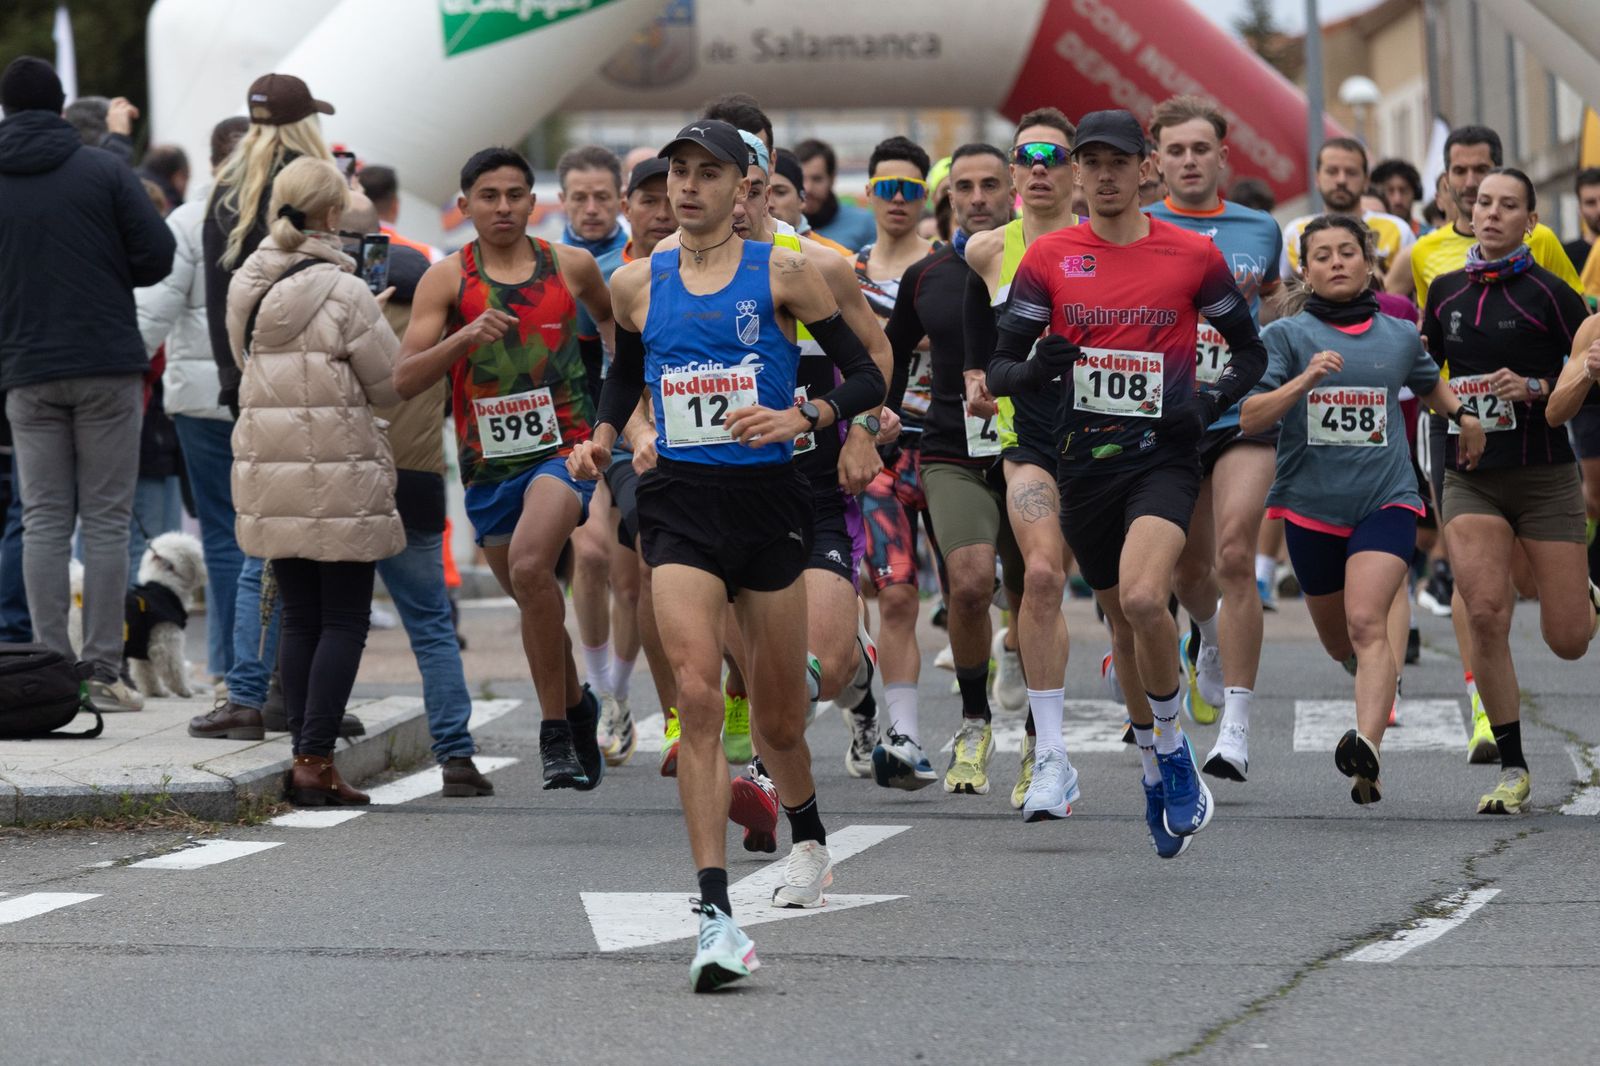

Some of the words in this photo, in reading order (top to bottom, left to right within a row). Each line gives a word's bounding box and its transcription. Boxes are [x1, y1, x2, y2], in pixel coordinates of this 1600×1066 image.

[751, 28, 942, 65] Salamanca
[663, 374, 754, 396] bedunia
[1088, 371, 1148, 402] 108
[1308, 390, 1385, 406] bedunia
[475, 394, 550, 416] bedunia
[687, 394, 729, 428] 12
[488, 411, 544, 442] 598
[1321, 407, 1375, 432] 458
